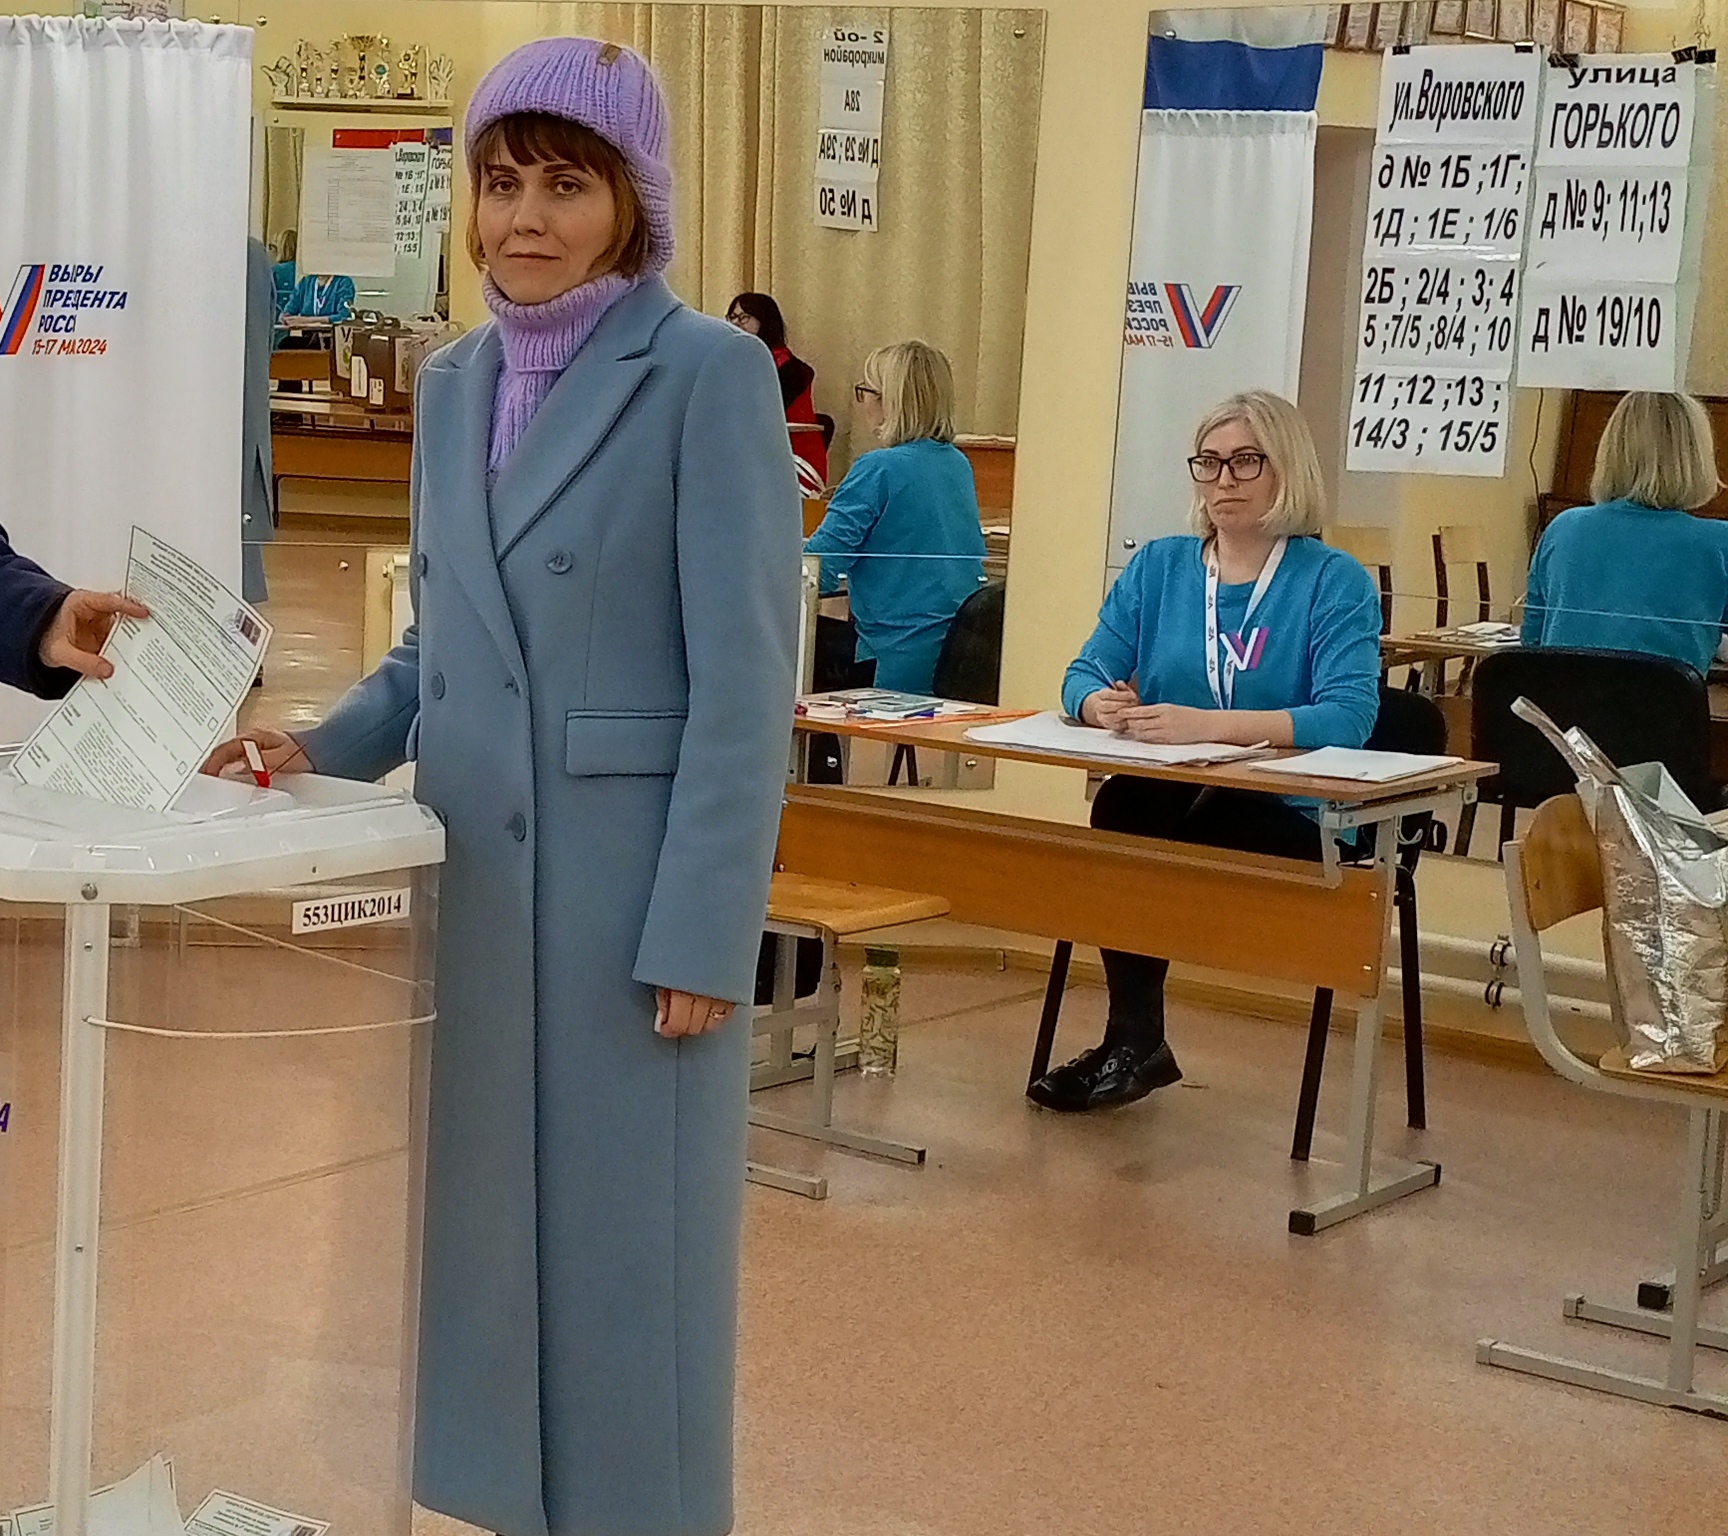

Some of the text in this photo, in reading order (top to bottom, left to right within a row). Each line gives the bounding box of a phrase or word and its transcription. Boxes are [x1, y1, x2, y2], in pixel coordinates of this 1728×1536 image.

[1568, 66, 1677, 89] улица
[1388, 68, 1525, 134] ул.Воровского
[1549, 101, 1680, 149] ГОРЬКОГО
[1377, 154, 1394, 189] д
[1400, 154, 1431, 189] №
[1439, 154, 1472, 189] 1Б
[1373, 207, 1404, 247] 1Д
[1428, 207, 1461, 239] 1Е
[1483, 207, 1519, 240] 1/6
[1540, 192, 1558, 240] д
[1562, 178, 1587, 231] №
[48, 264, 104, 283] ВЫРЫ
[1364, 266, 1396, 305] 2Б
[1416, 267, 1451, 305] 2/4
[1499, 268, 1515, 307] 4
[42, 289, 128, 310] ПРЕДЕНТА
[37, 314, 76, 334] РОСС
[1363, 314, 1376, 348] 5
[1487, 315, 1512, 352] 10
[1531, 294, 1661, 352] д № 19/10
[1358, 372, 1386, 404] 11
[1352, 416, 1410, 450] 14/3
[1439, 419, 1500, 453] 15/5
[302, 894, 402, 927] 553ЦИК2014
